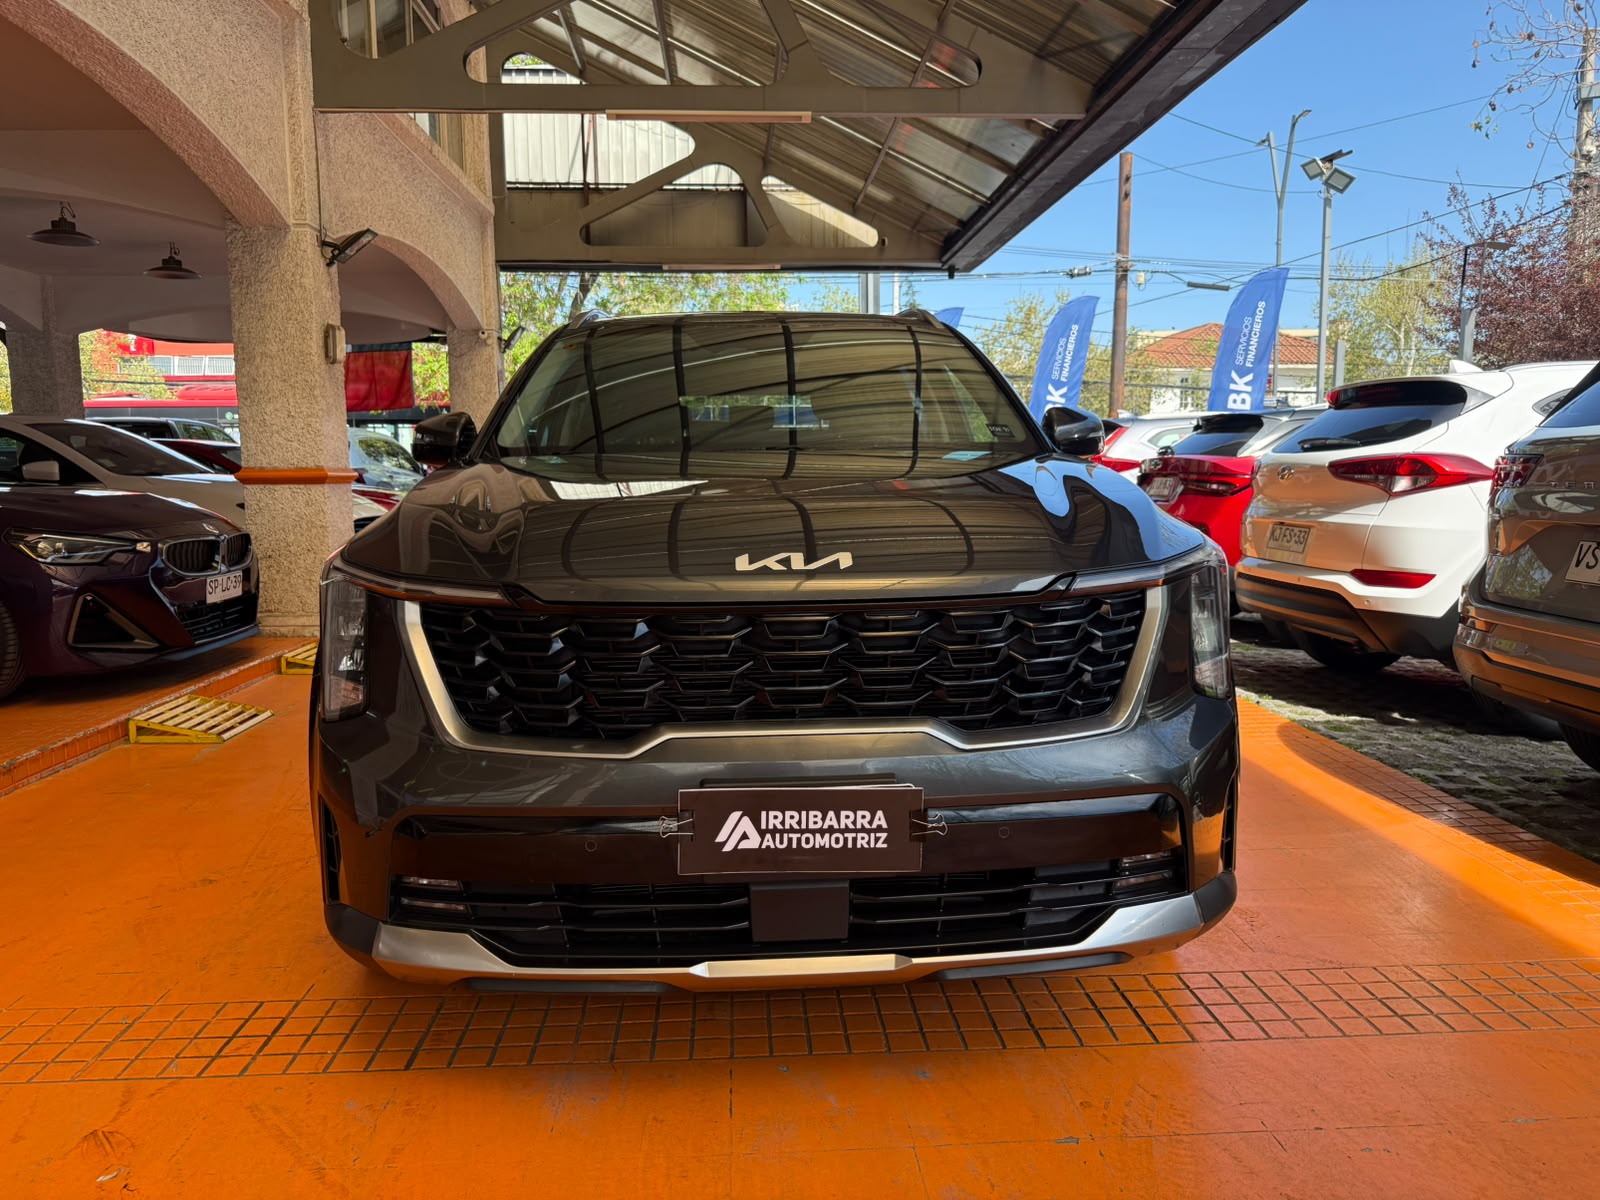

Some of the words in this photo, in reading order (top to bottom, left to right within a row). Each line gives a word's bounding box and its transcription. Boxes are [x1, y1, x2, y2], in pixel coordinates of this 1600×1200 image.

[1060, 324, 1079, 382] FINANCIEROS
[1235, 316, 1253, 366] SERVICIOS
[1245, 300, 1266, 368] FINANCIEROS
[1051, 337, 1067, 380] SERVICIOS
[1044, 383, 1069, 415] K
[1227, 369, 1254, 411] BK
[735, 552, 853, 571] KIA
[760, 810, 888, 829] IRRIBARRA
[760, 832, 888, 849] AUTOMOTRIZ
